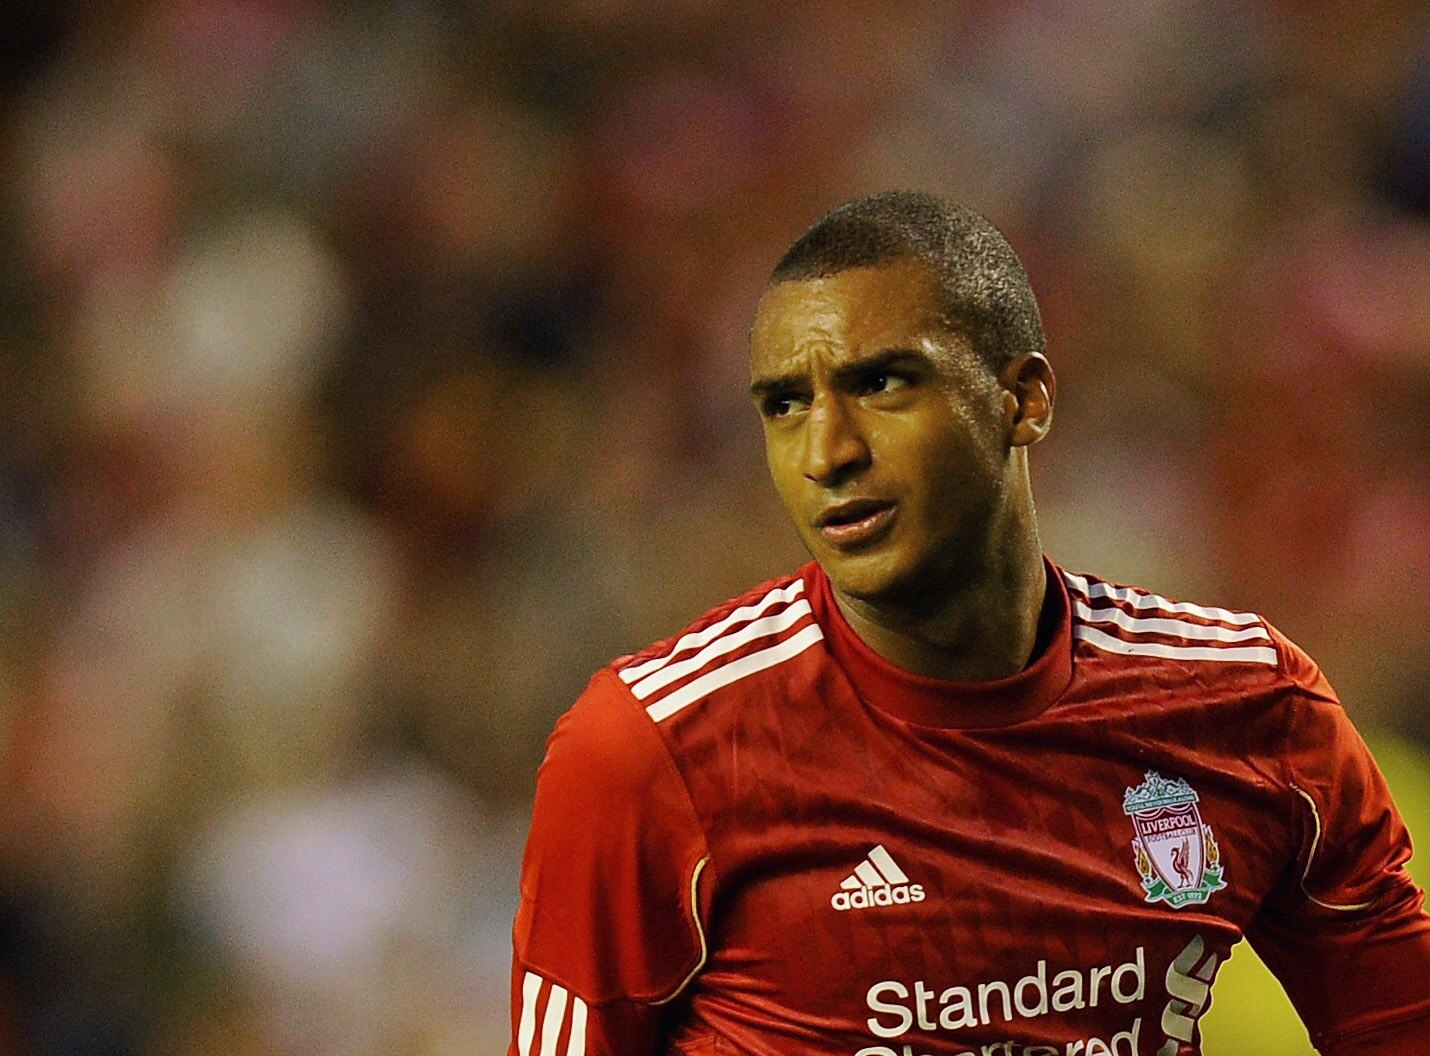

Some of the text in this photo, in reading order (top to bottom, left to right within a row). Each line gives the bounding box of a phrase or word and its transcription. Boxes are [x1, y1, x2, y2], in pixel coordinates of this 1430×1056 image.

[1142, 815, 1196, 834] LIVERPOOL
[831, 881, 926, 911] adidas
[866, 946, 1146, 1038] Standard
